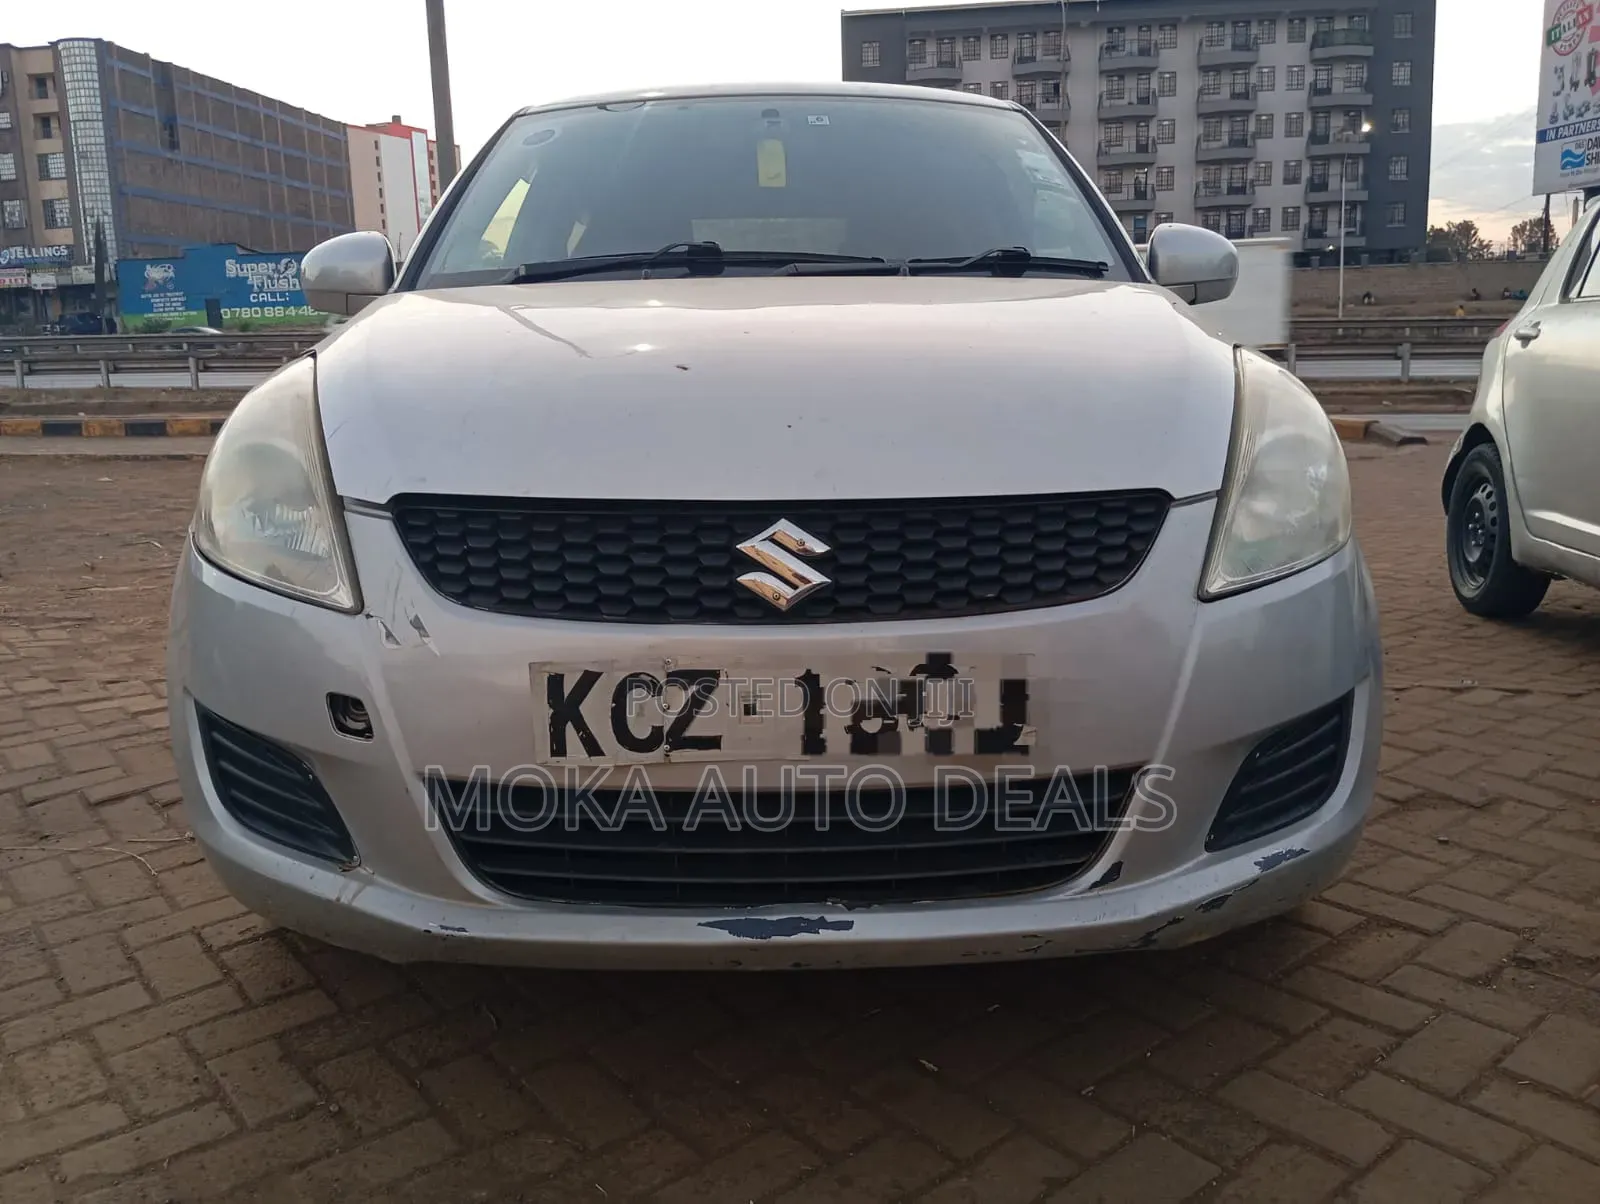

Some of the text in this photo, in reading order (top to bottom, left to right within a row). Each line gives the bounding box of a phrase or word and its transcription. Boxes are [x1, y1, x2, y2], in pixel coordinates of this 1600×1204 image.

[1546, 129, 1556, 141] IN
[249, 293, 289, 302] CALL:
[220, 306, 261, 319] 0780
[547, 669, 723, 757] KCZ
